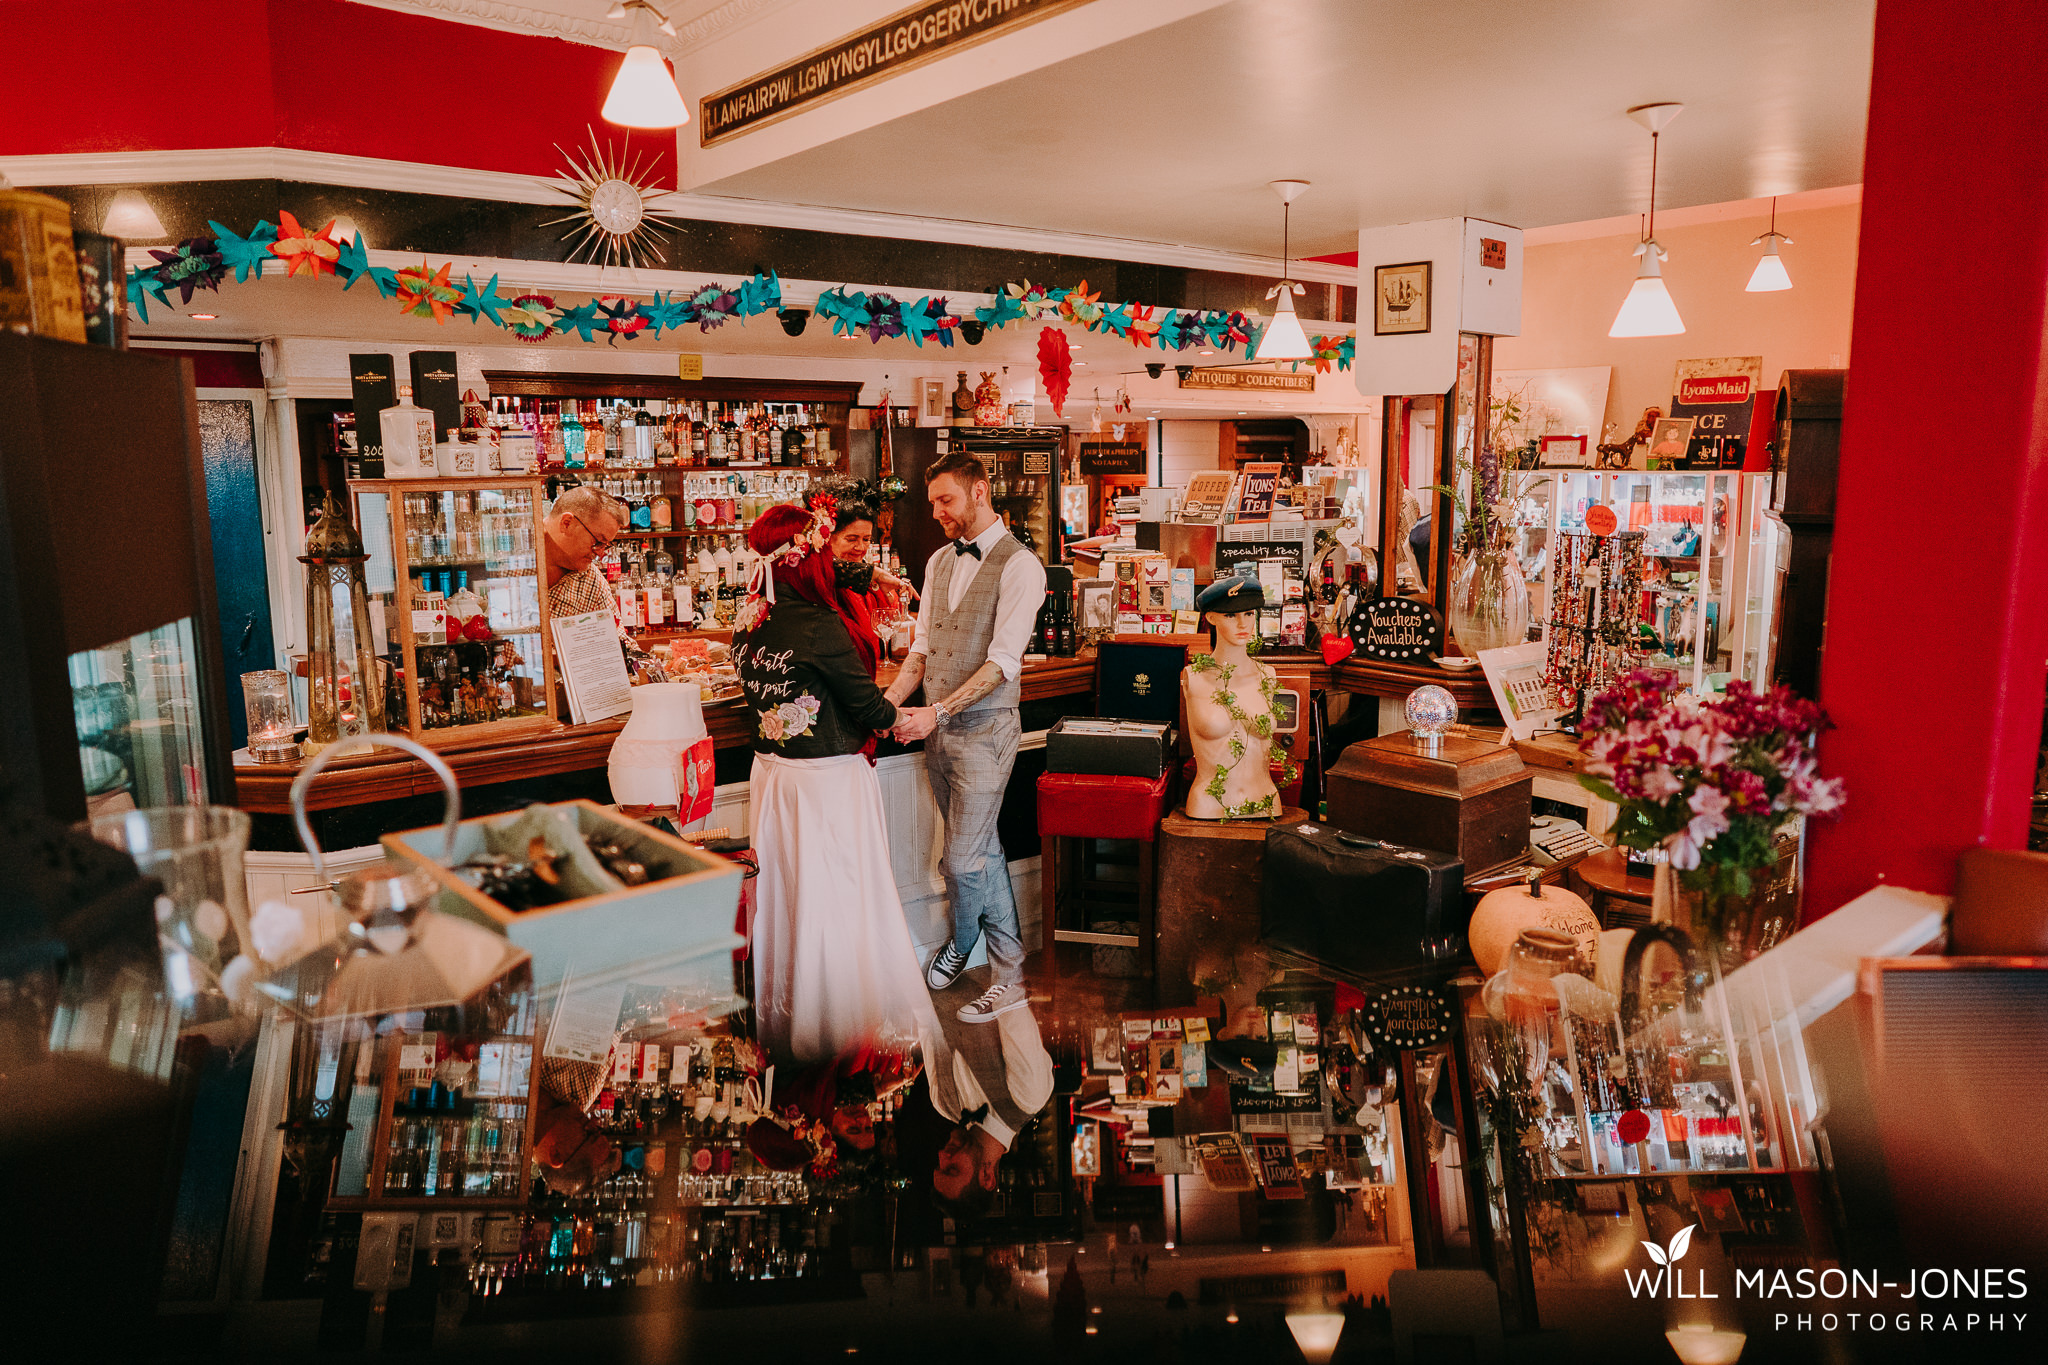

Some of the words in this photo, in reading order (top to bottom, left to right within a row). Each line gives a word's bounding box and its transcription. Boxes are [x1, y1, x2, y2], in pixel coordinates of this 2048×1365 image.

[1246, 375, 1309, 387] COLLECTIBLES
[1683, 383, 1715, 399] Lyons
[1716, 381, 1747, 395] Maid
[1192, 481, 1228, 493] COFFEE
[1245, 499, 1267, 514] TEA
[1222, 545, 1269, 559] speciality
[1275, 547, 1300, 556] teas
[1370, 609, 1422, 627] Vouchers
[1367, 627, 1423, 645] Available
[761, 680, 797, 700] part
